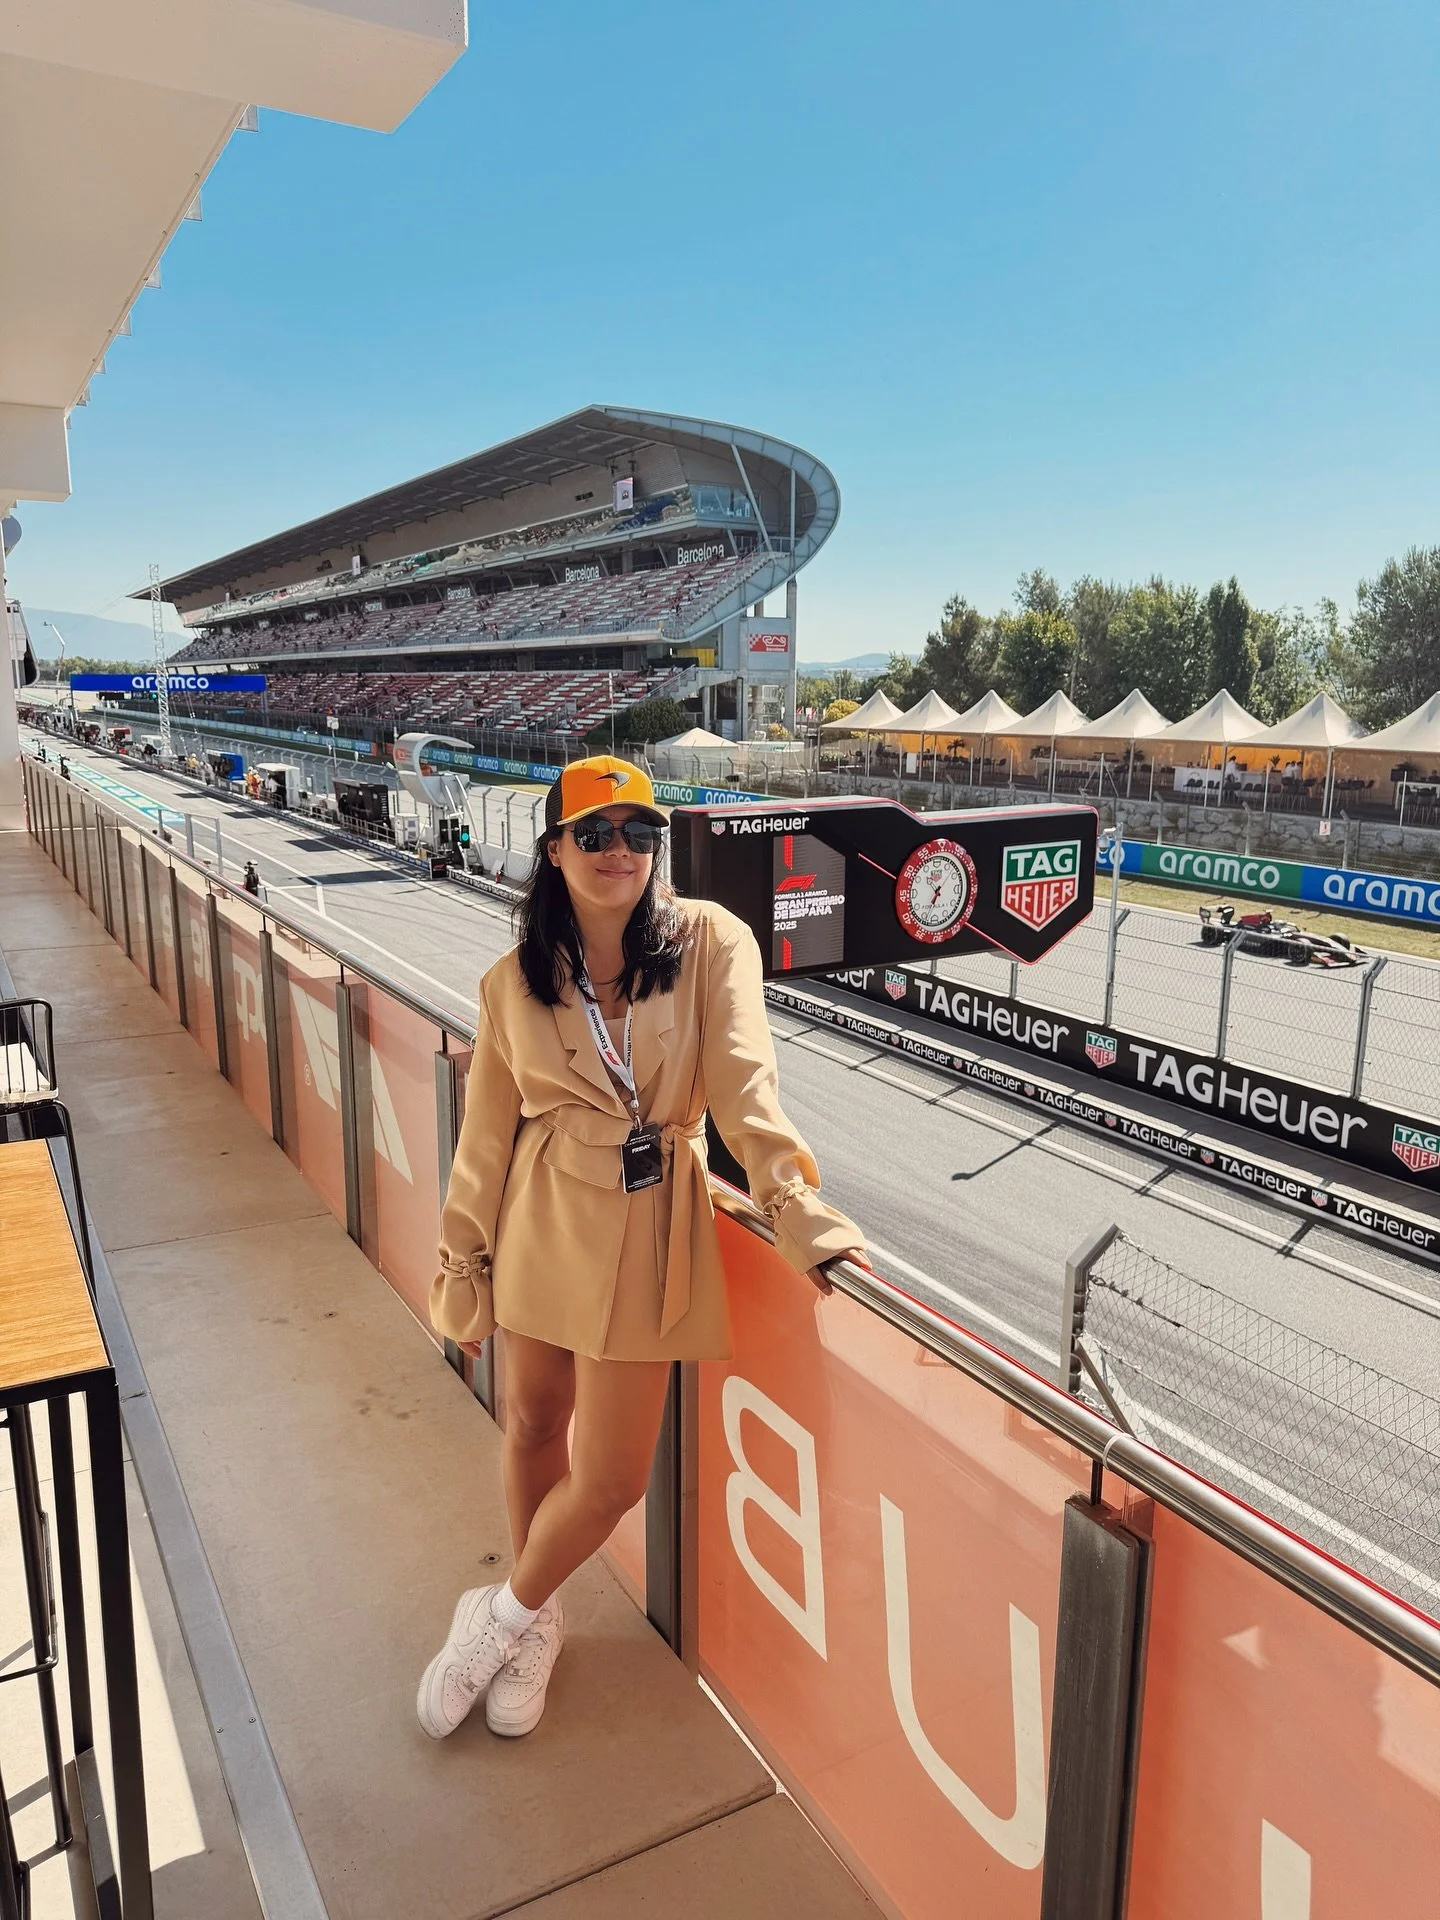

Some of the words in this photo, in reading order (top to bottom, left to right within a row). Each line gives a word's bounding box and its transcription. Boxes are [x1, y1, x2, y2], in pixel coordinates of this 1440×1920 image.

[677, 542, 725, 565] Barcelona
[565, 565, 600, 582] Barcelona
[477, 757, 499, 771] aramco
[503, 762, 528, 776] aramco
[1010, 848, 1074, 878] TAG
[1159, 850, 1280, 889] aramco
[774, 899, 805, 911] GRAN
[805, 895, 845, 908] PREMIO
[1007, 881, 1074, 923] HEUER
[774, 910, 788, 920] DE
[774, 921, 797, 931] 2025
[887, 972, 906, 984] TAG
[589, 1008, 608, 1050] Experiences
[1087, 1032, 1115, 1049] TAG
[1086, 1048, 1116, 1067] HEUER
[1398, 1128, 1437, 1151] TAG
[631, 1143, 651, 1154] FRIDAY
[1395, 1143, 1437, 1168] HEUER
